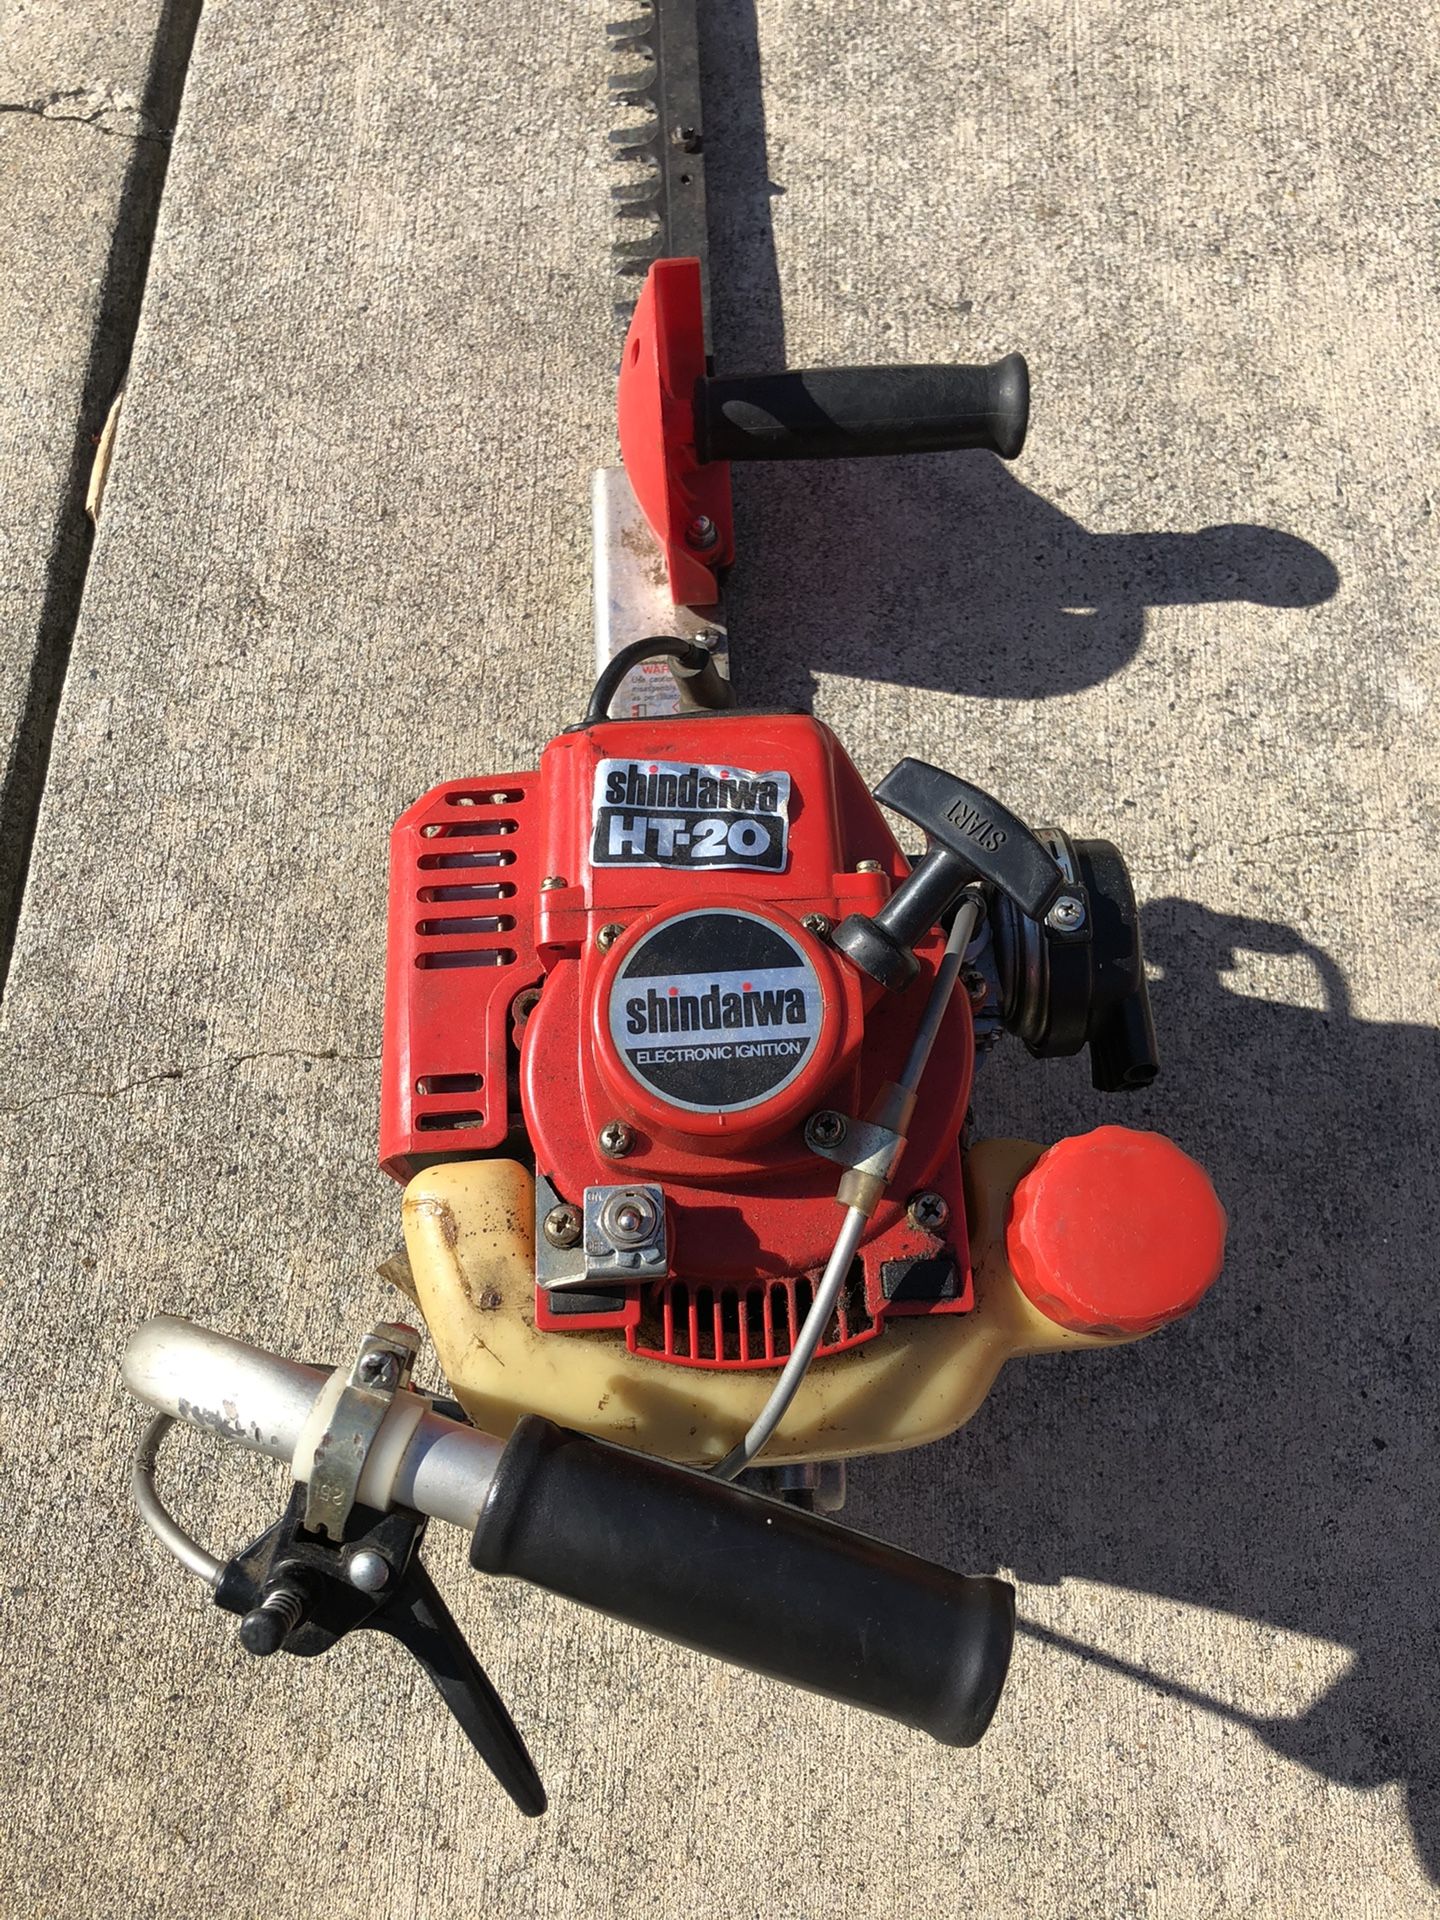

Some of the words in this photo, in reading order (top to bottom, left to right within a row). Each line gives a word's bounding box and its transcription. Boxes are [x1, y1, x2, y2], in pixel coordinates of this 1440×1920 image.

[606, 764, 778, 812] shindaiwa
[608, 815, 771, 859] HT-20
[944, 799, 1007, 852] START
[626, 981, 807, 1035] shindaiwa
[636, 1046, 732, 1065] ELECTRONIC
[735, 1041, 801, 1058] IGNITION
